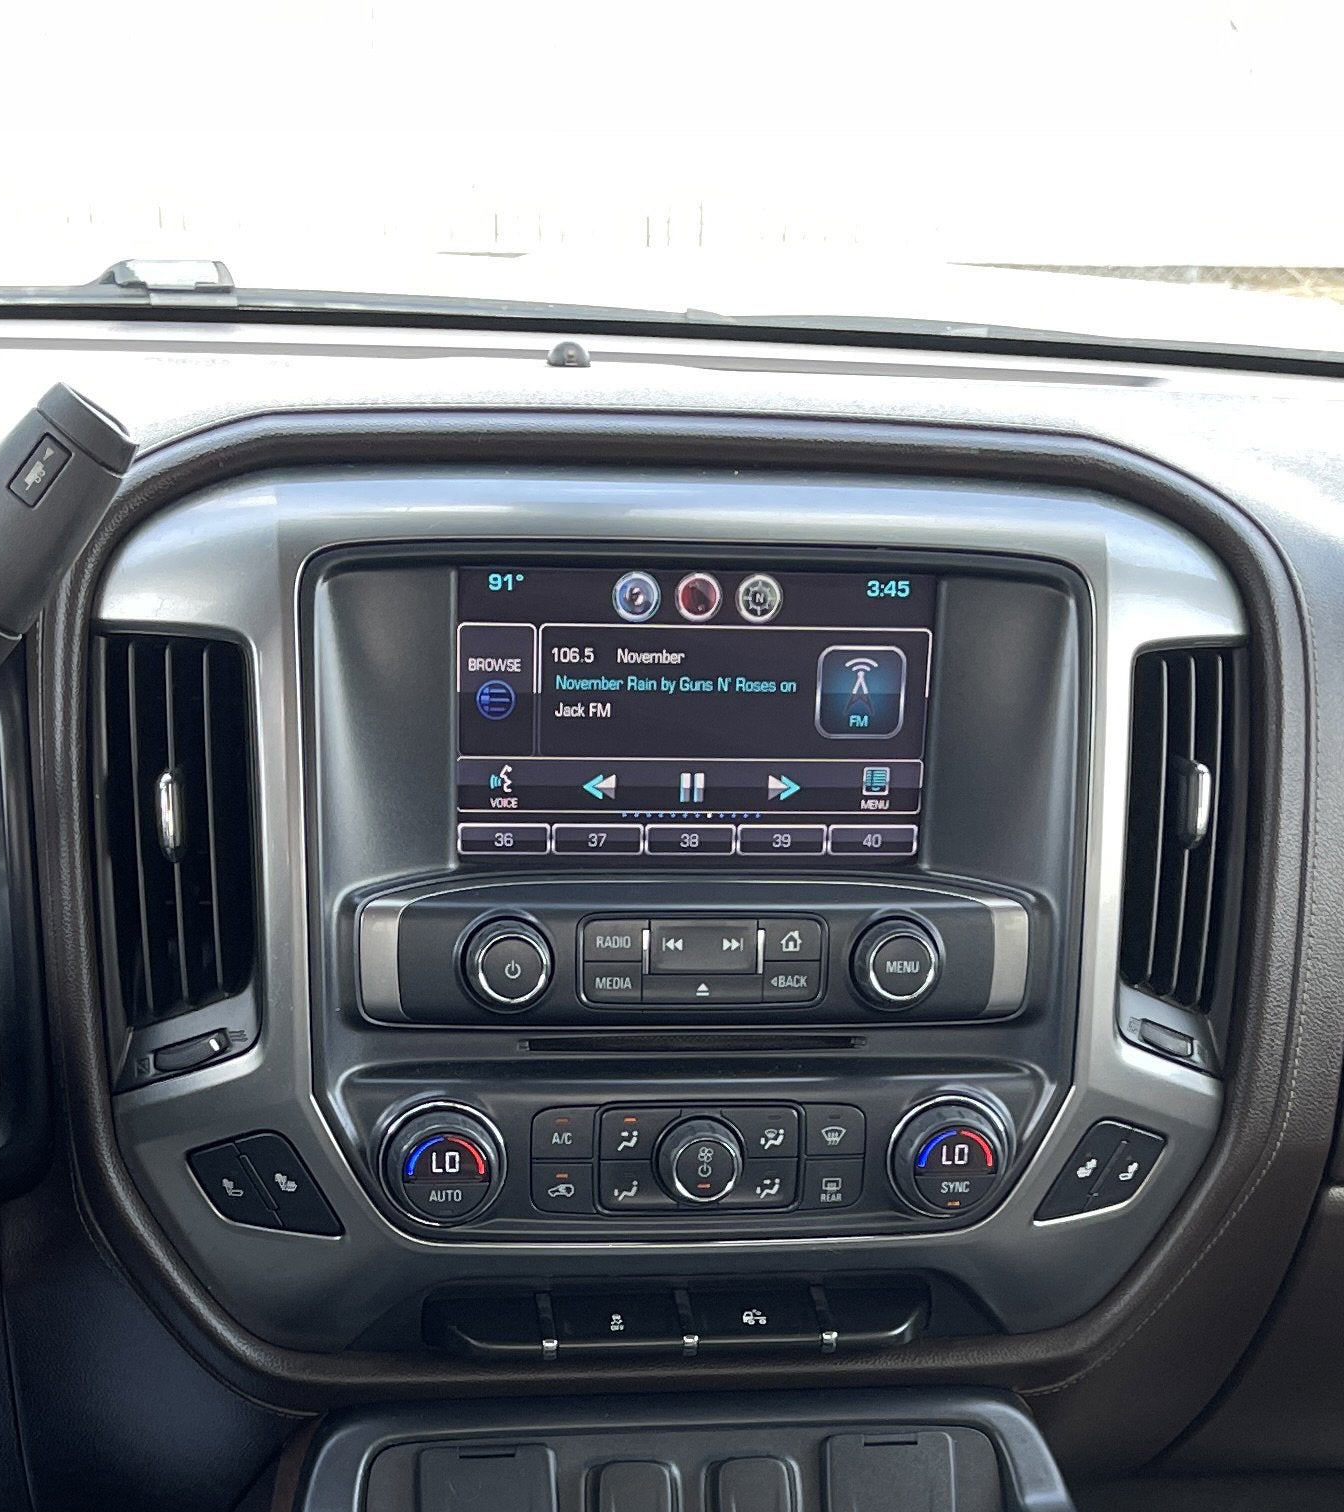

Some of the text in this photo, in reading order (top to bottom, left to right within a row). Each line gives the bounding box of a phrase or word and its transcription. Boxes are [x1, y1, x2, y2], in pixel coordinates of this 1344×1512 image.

[488, 574, 524, 592] 91°
[866, 580, 911, 598] 3:45
[551, 647, 685, 665] 106.5 November
[468, 658, 522, 673] BROWSE
[555, 676, 624, 693] November
[627, 677, 658, 693] Rain
[661, 677, 676, 696] by
[679, 678, 714, 693] Guns
[736, 679, 776, 694] Roses
[780, 681, 797, 694] on
[555, 703, 611, 719] Jack FM
[849, 715, 868, 728] FM
[490, 797, 518, 809] VOICE
[860, 799, 890, 810] MENU
[494, 833, 514, 848] 36
[587, 833, 607, 848] 37
[679, 833, 700, 848] 38
[772, 834, 792, 848] 39
[862, 834, 882, 848] 40
[595, 935, 631, 950] RADIO
[885, 958, 921, 975] MENU
[595, 975, 632, 991] MEDIA
[778, 973, 808, 990] BACK
[551, 1130, 573, 1146] A/C
[941, 1143, 969, 1167] LO
[431, 1151, 460, 1175] LO
[940, 1180, 971, 1195] SYNC
[428, 1189, 462, 1204] AUTO
[820, 1192, 843, 1203] REAR
